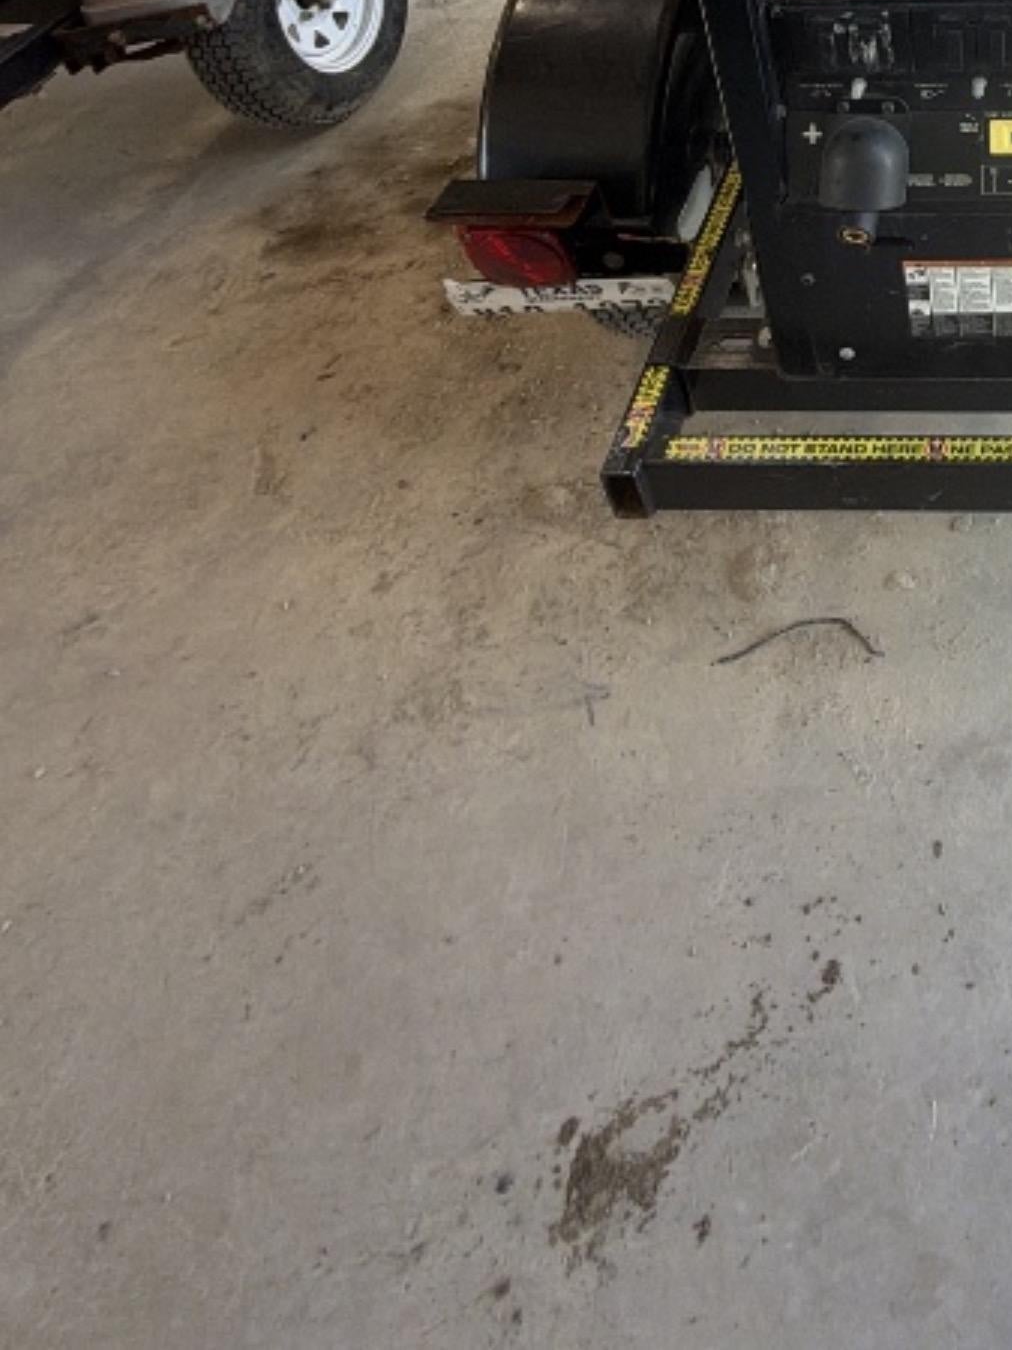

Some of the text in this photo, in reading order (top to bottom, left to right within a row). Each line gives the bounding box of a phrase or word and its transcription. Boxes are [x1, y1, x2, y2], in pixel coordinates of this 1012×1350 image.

[728, 443, 757, 454] DO
[761, 443, 802, 454] NOT
[803, 443, 868, 454] STAND
